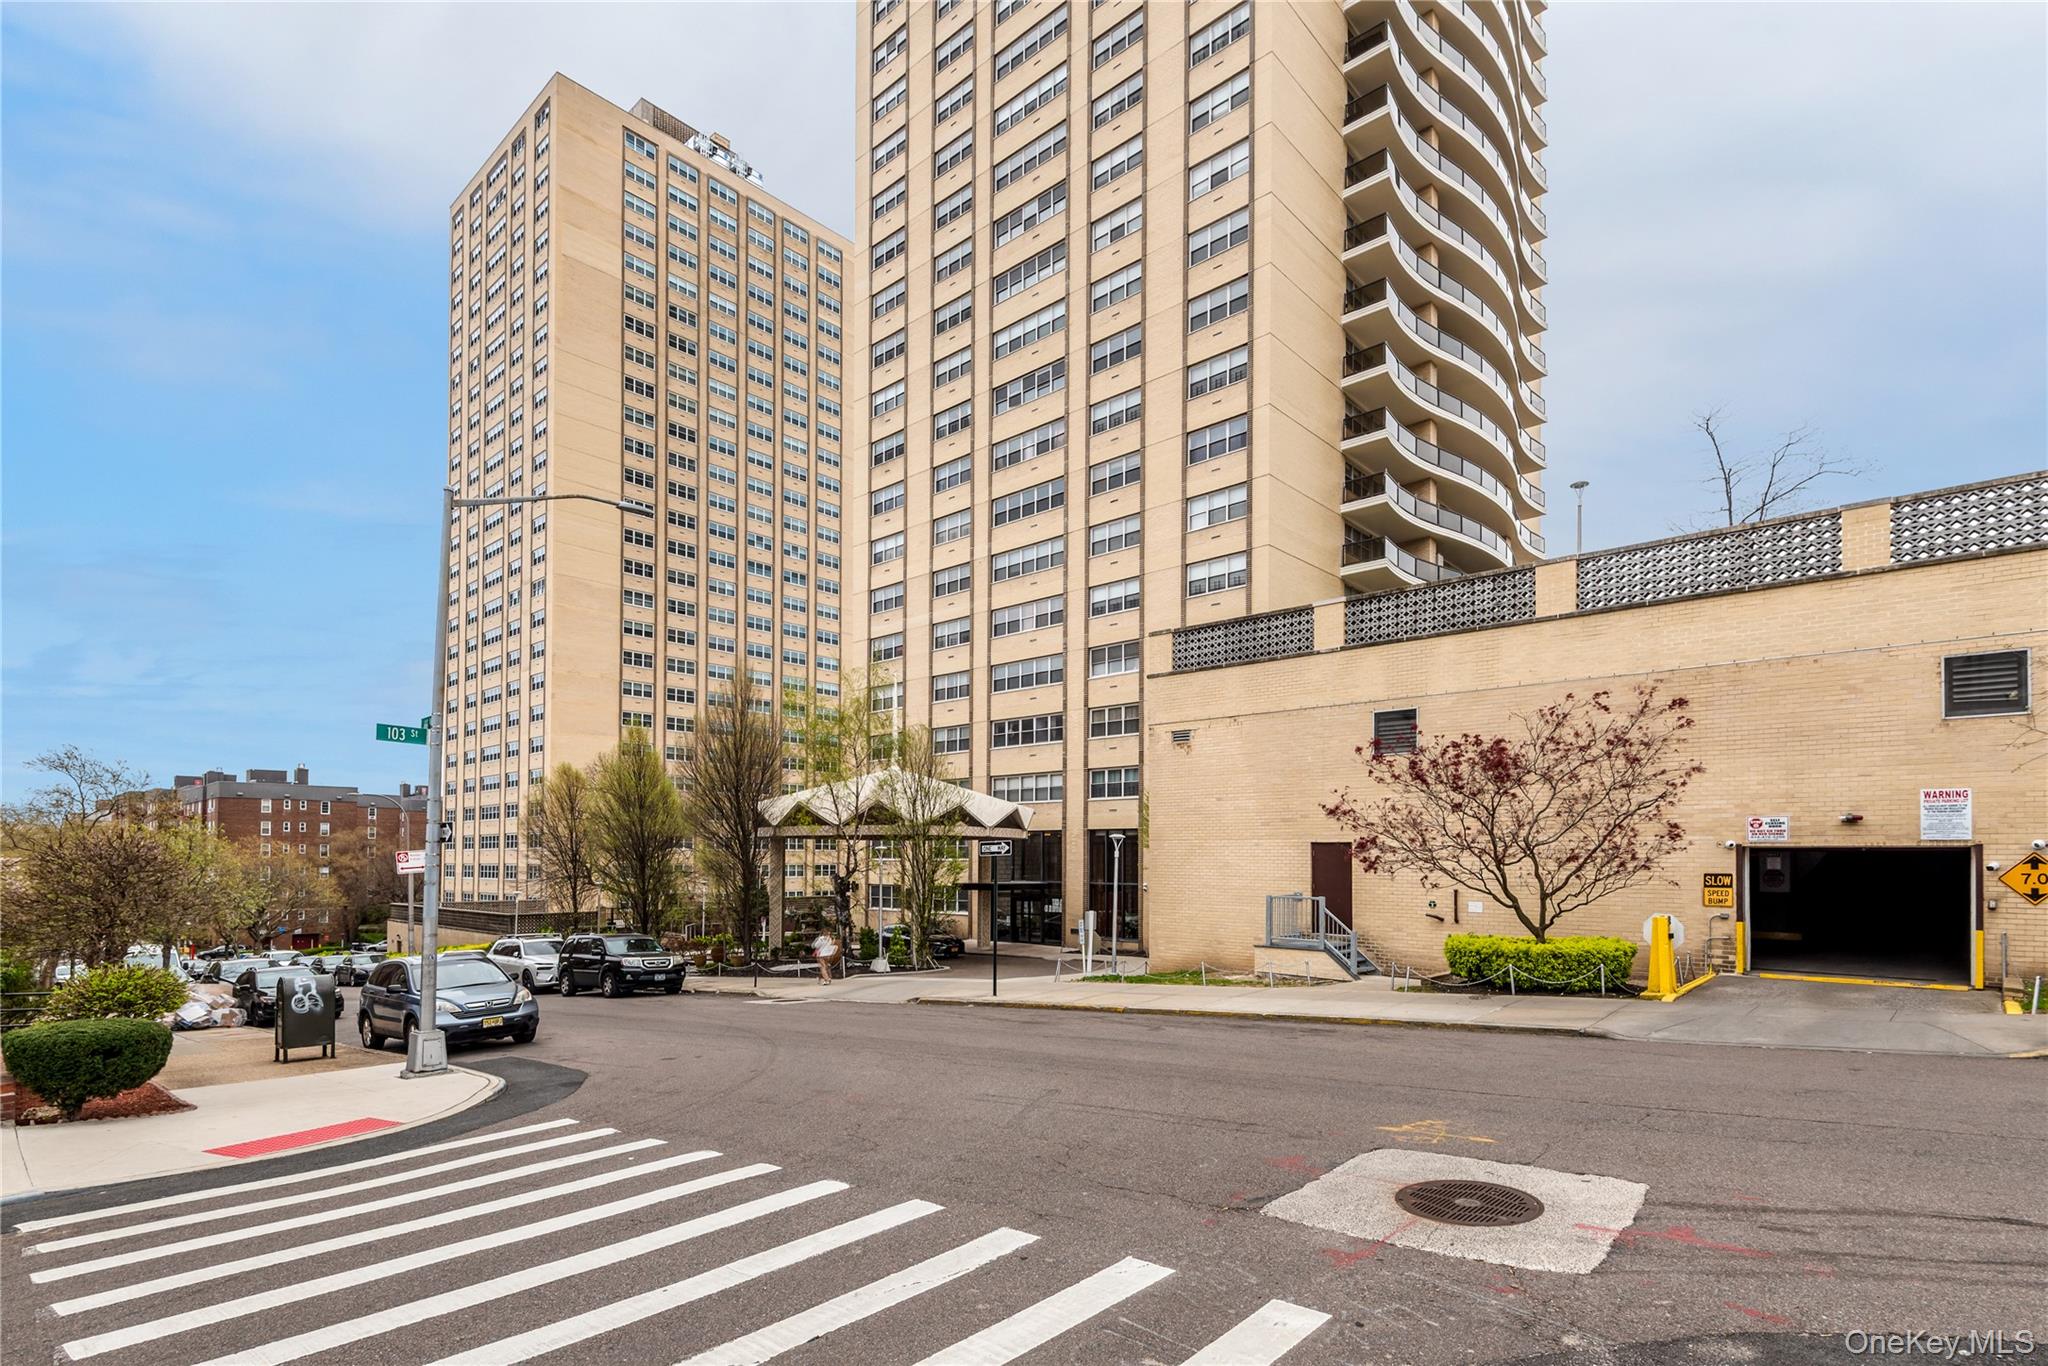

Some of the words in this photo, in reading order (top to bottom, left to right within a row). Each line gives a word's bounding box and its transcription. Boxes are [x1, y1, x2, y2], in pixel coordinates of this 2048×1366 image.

[387, 727, 406, 741] 103
[1923, 790, 1969, 799] WARNING
[1705, 875, 1732, 886] SLOW
[2021, 873, 2048, 885] 7.0
[1707, 889, 1730, 897] SPEED
[1708, 897, 1729, 905] BUMP
